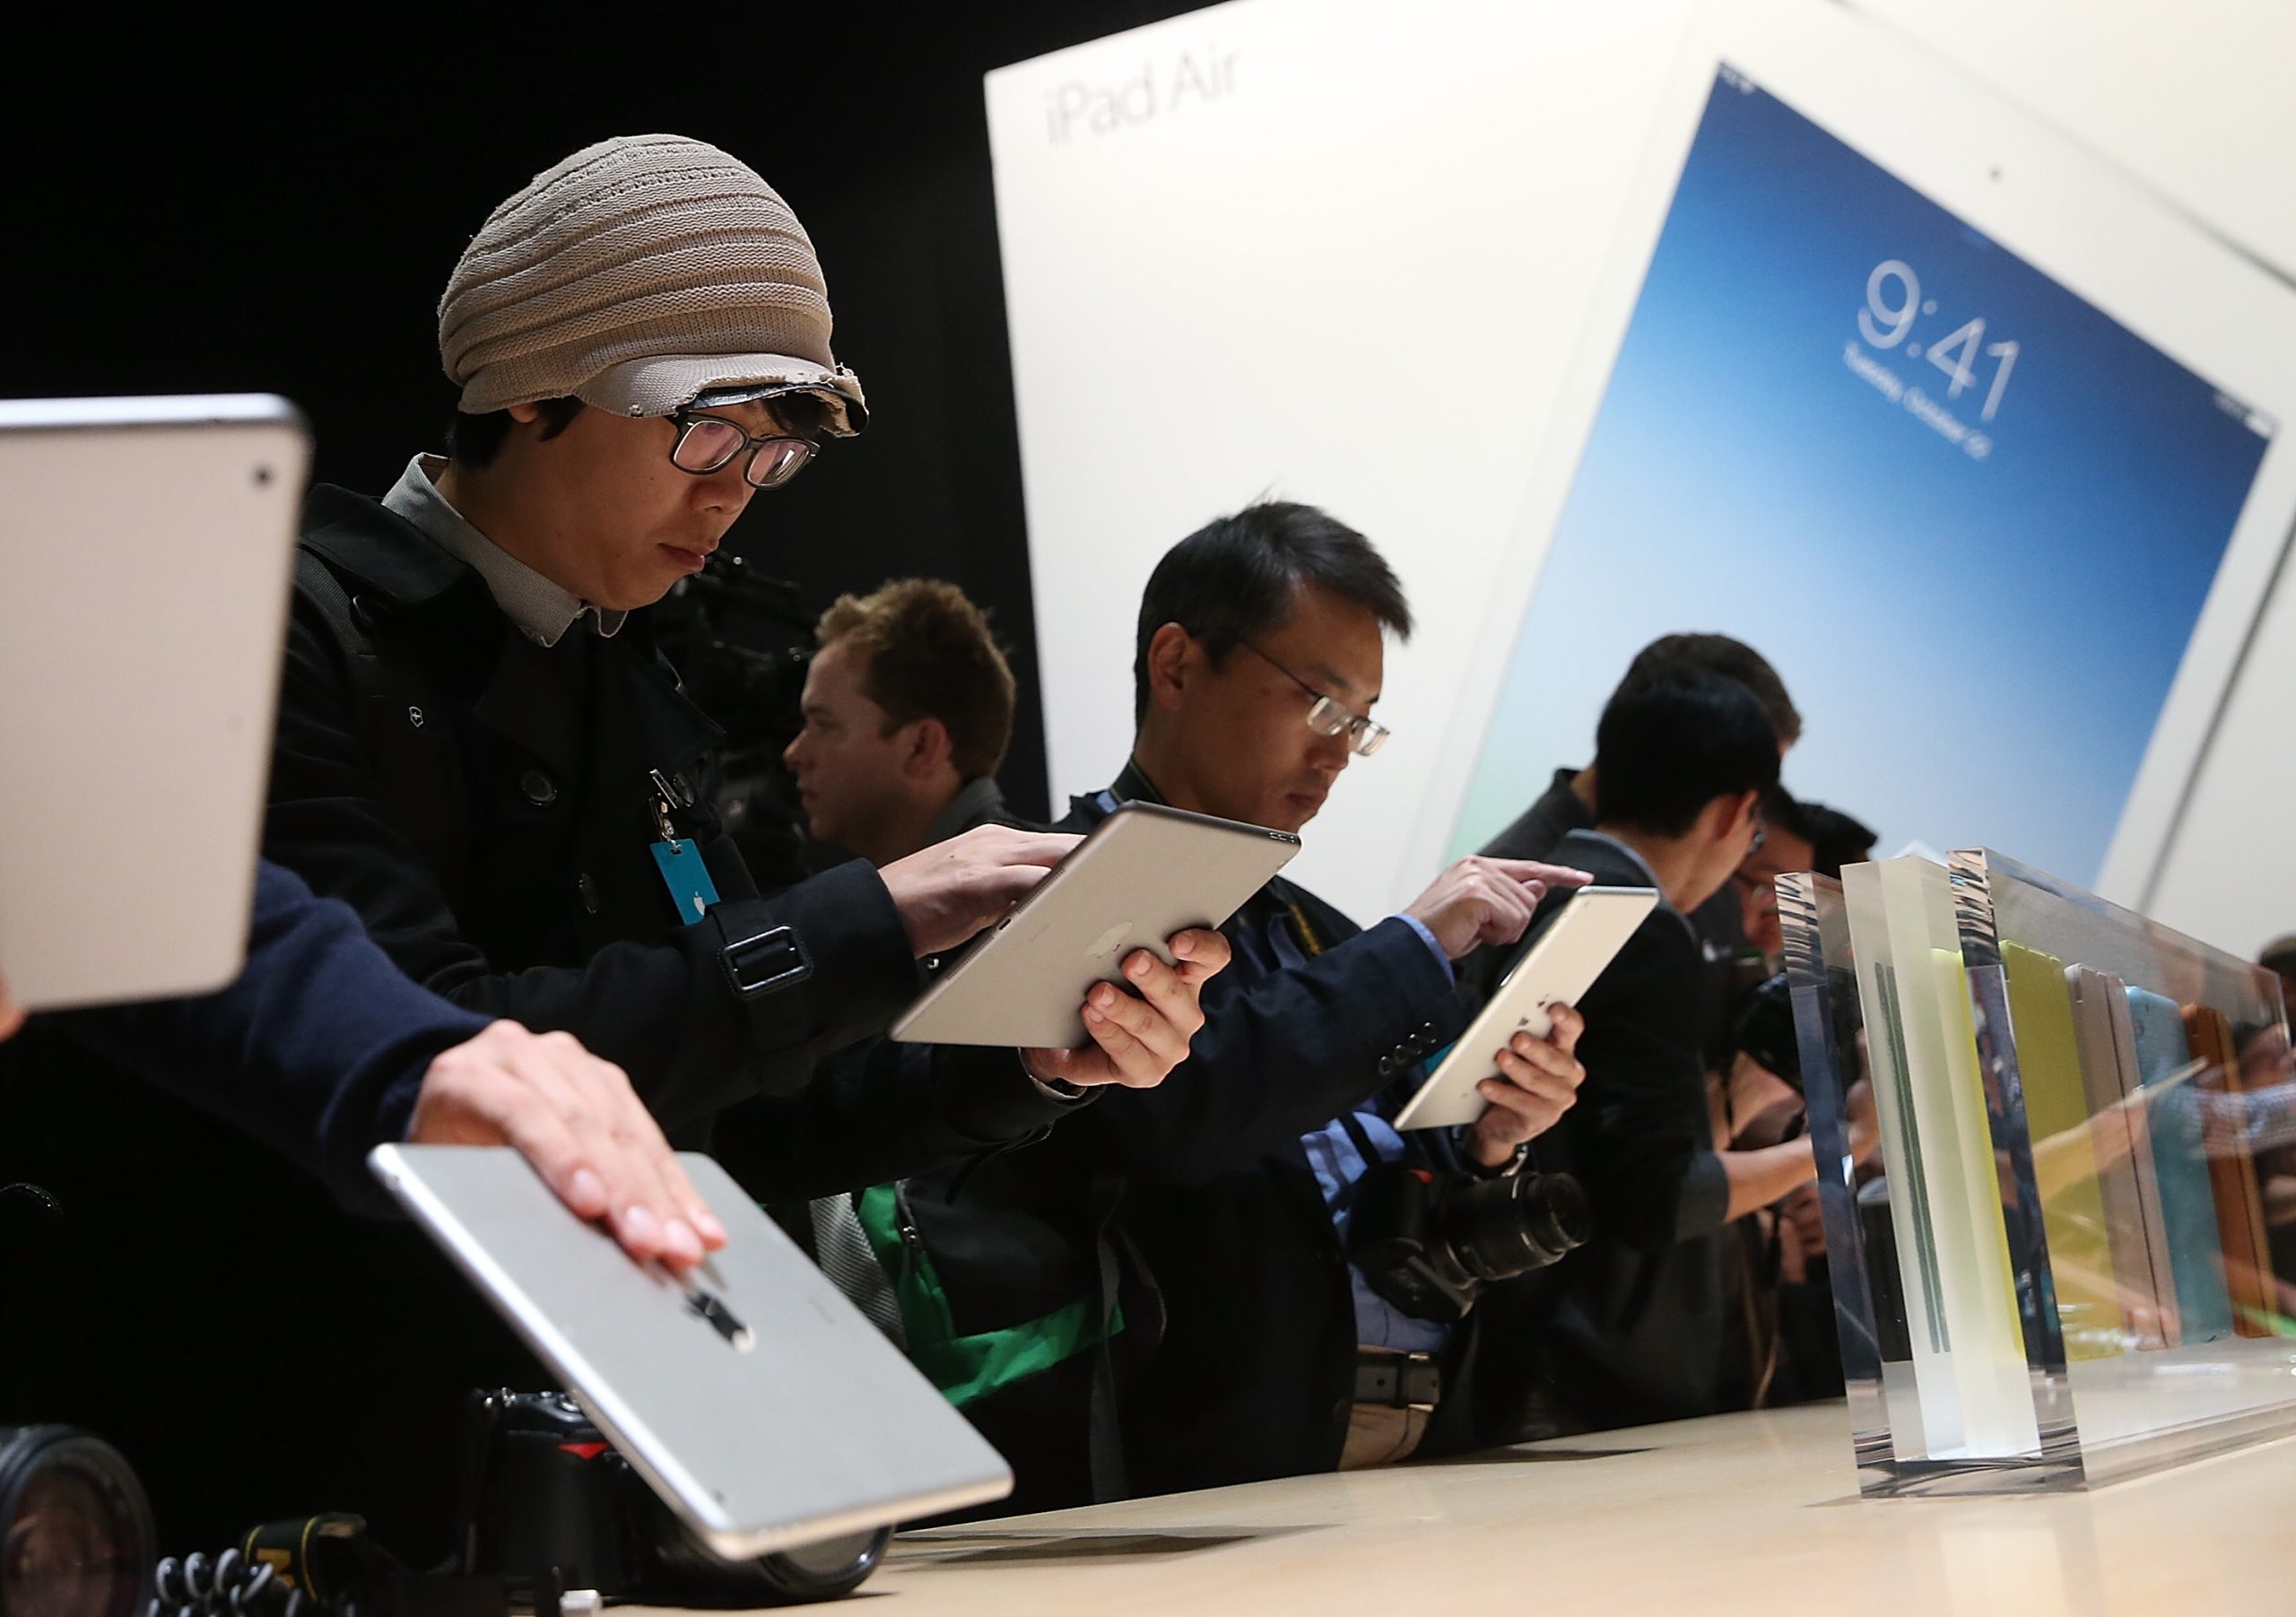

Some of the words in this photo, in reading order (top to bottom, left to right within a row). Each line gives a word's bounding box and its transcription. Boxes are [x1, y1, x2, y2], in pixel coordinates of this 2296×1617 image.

[1045, 58, 1158, 147] iPad
[1168, 41, 1242, 112] Air
[1858, 259, 2020, 422] 9:41
